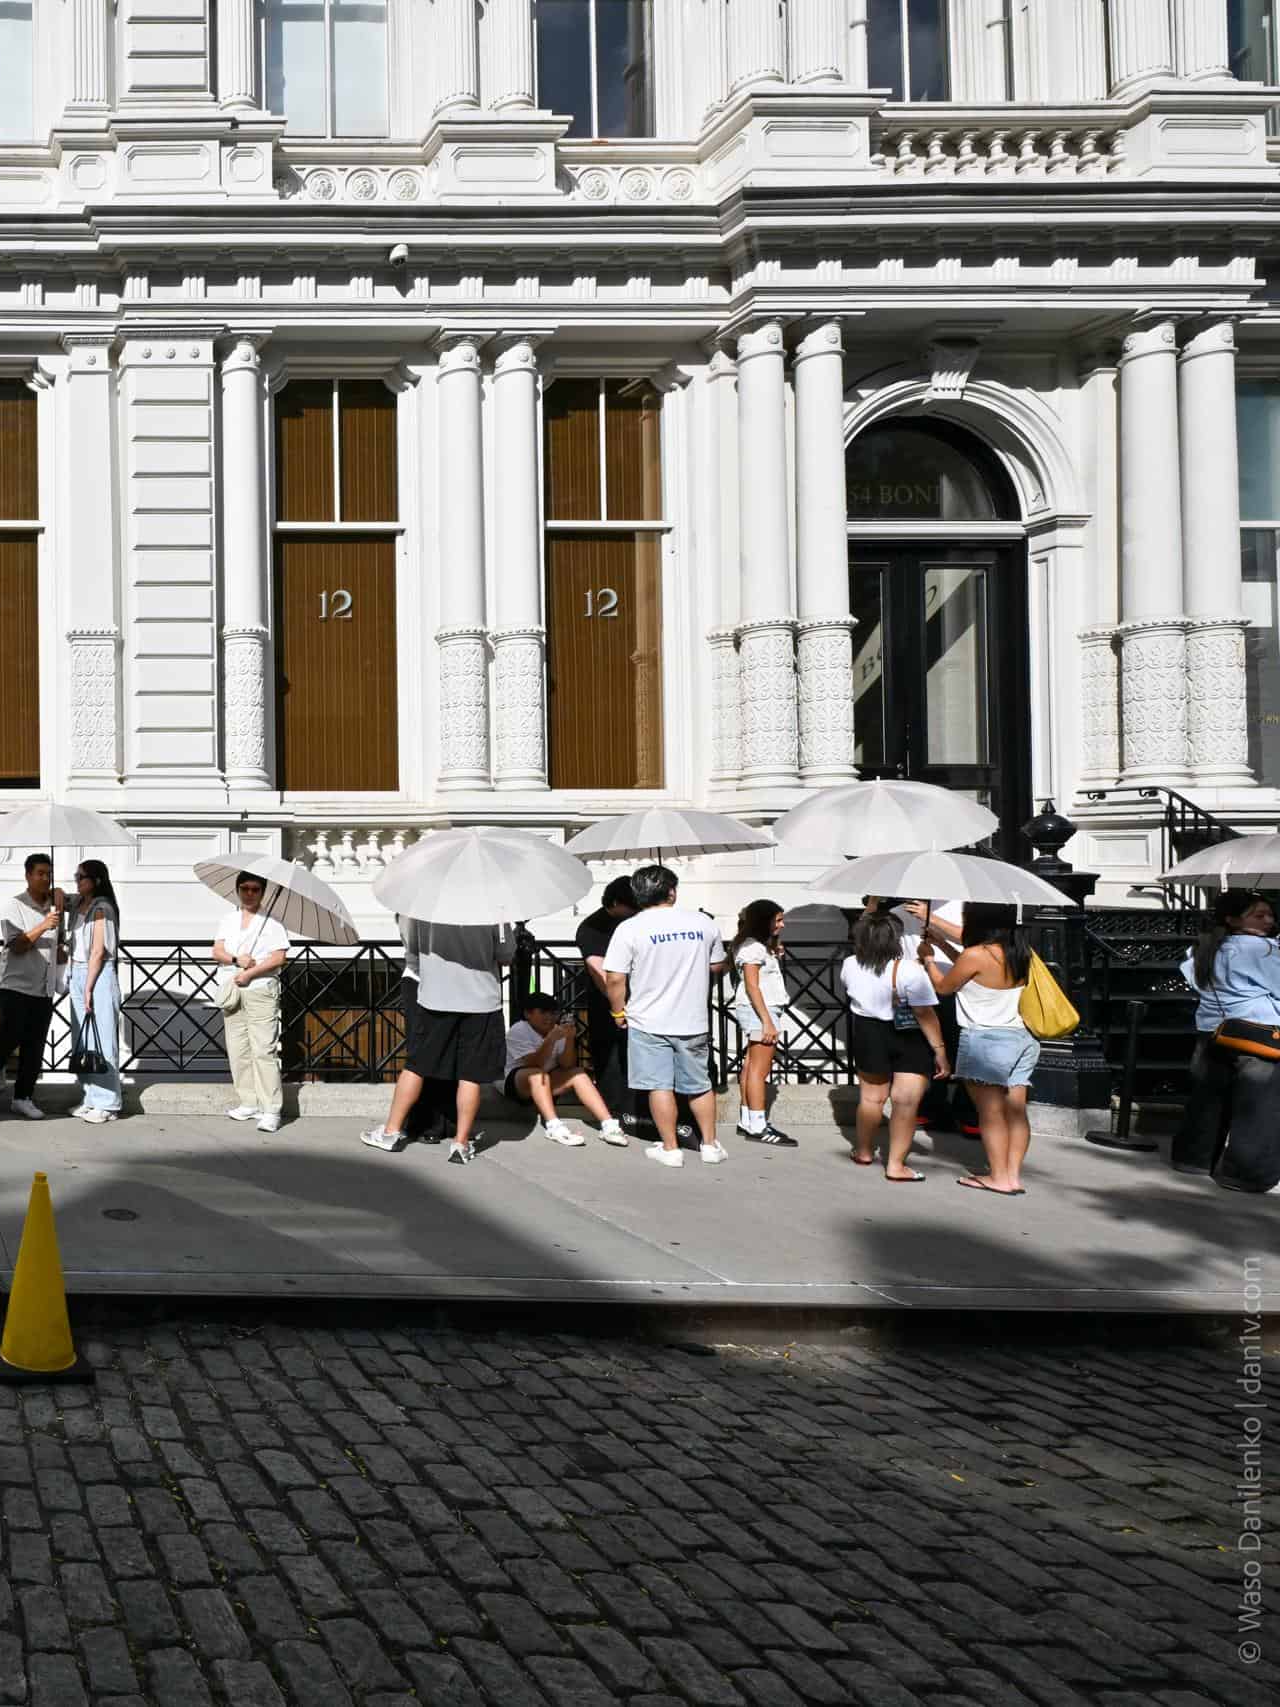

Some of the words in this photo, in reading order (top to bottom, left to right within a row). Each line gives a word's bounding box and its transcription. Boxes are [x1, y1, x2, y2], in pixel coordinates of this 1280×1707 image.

[318, 589, 353, 619] 12
[583, 587, 618, 617] 12
[649, 930, 704, 945] VUITTON
